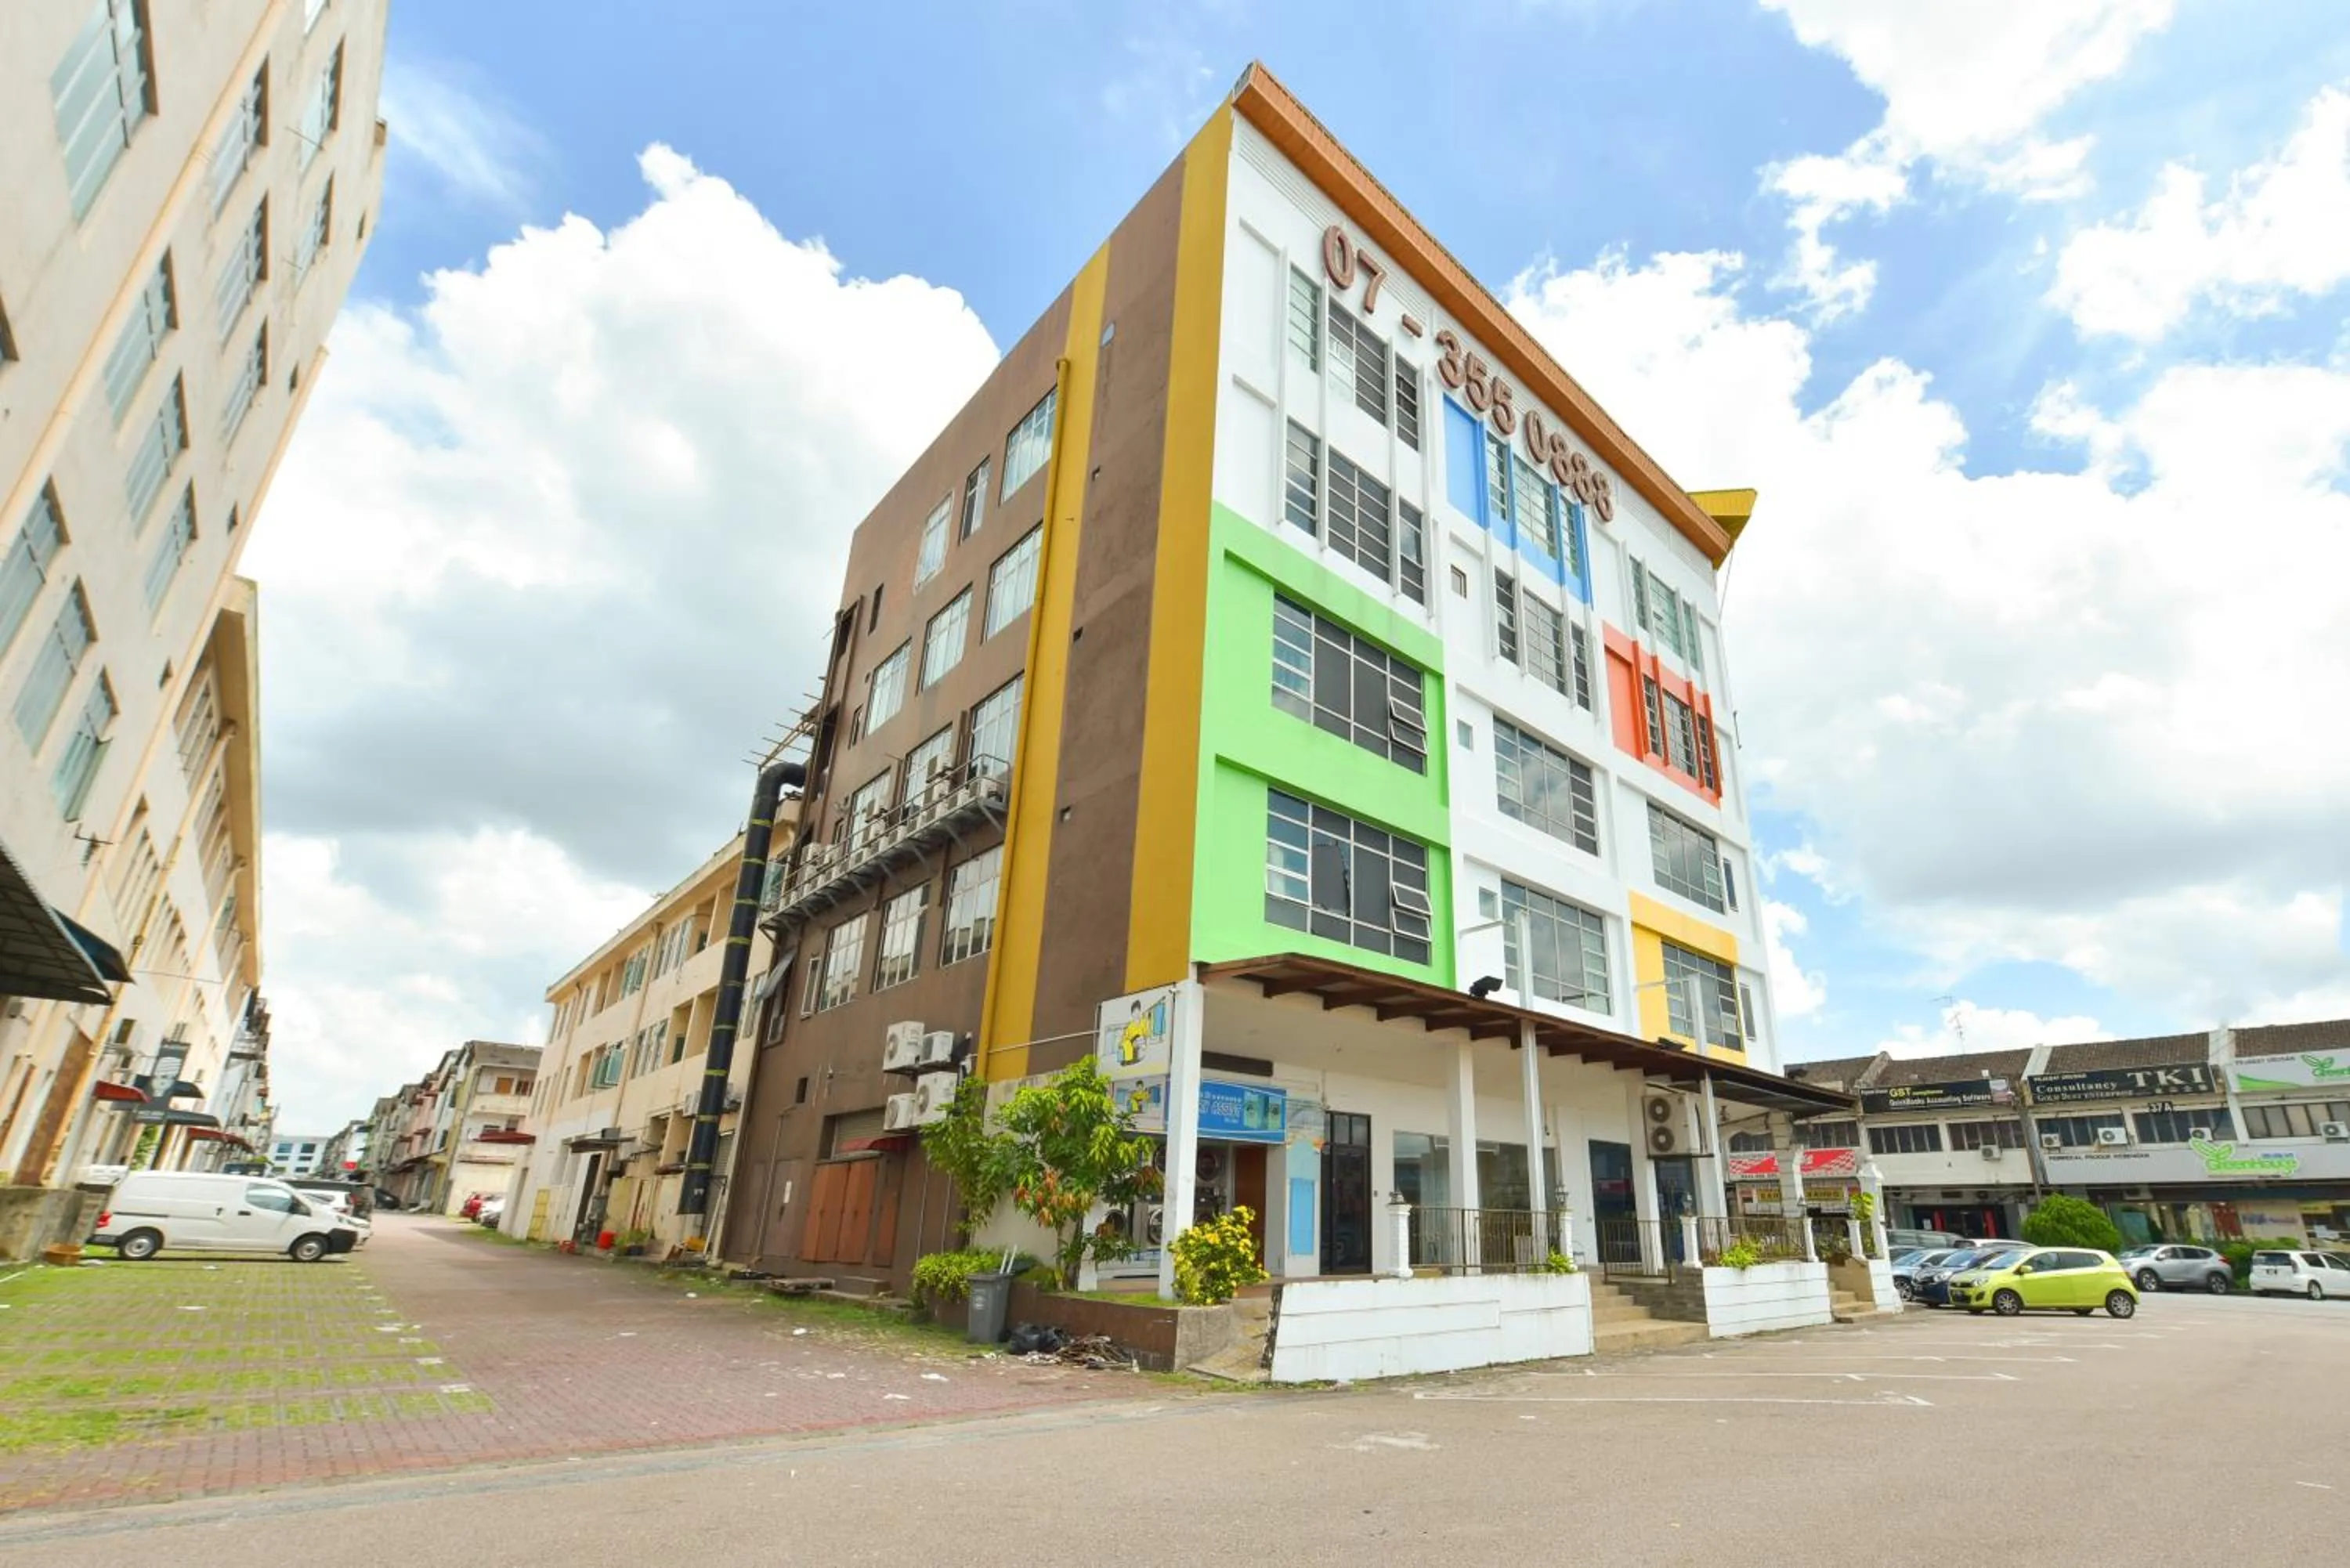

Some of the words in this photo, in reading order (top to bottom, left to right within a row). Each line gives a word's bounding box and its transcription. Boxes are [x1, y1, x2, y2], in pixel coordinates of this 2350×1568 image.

[1322, 225, 1390, 314] 07
[1435, 327, 1517, 435] 355
[1524, 409, 1615, 523] 0888
[2036, 1081, 2118, 1094] Consultancy
[2127, 1067, 2204, 1088] TKI
